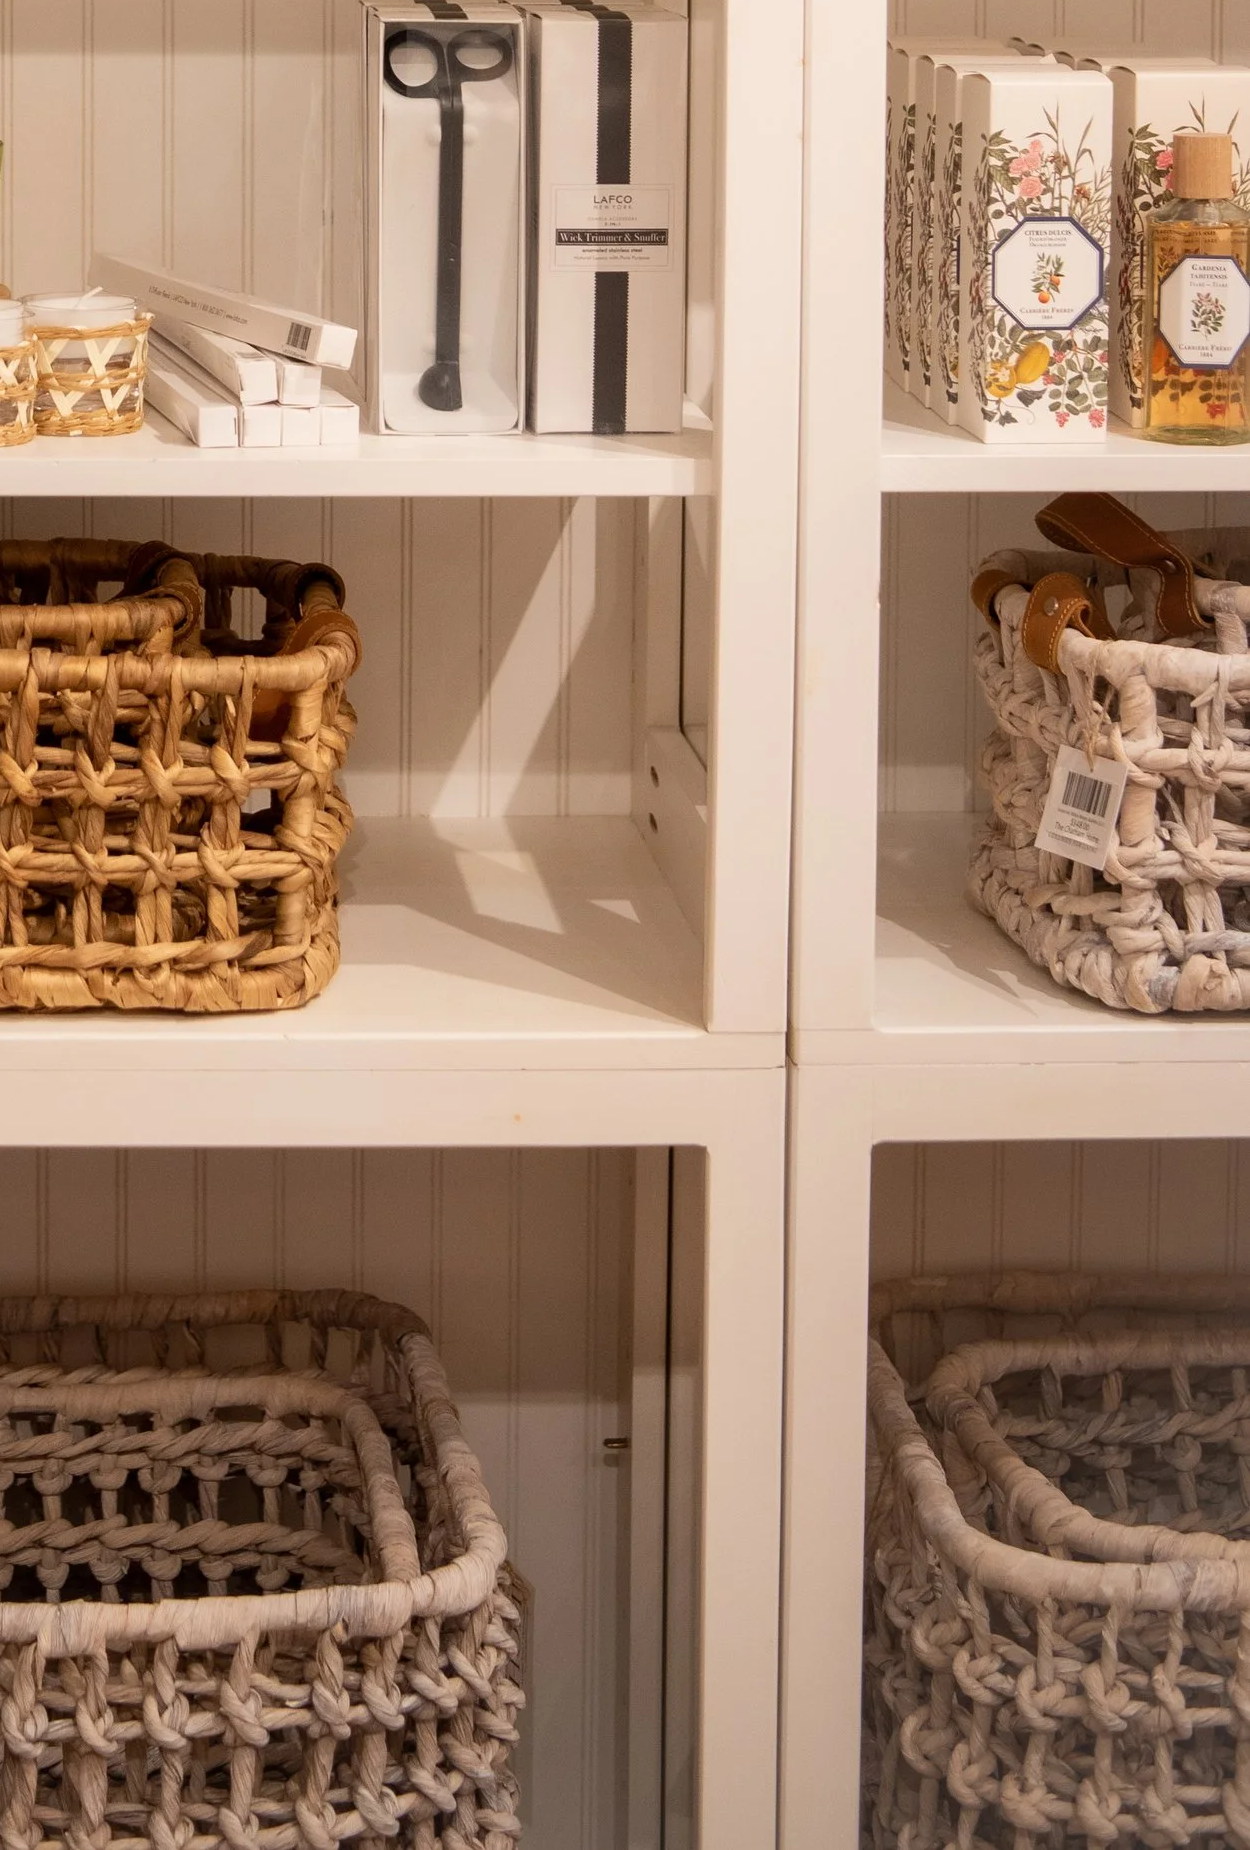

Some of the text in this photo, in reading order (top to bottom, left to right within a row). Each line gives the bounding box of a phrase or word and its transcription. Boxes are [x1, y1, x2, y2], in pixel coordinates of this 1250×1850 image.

[594, 195, 632, 204] LAFCO
[560, 232, 666, 242] Wick Trimmer & Snuffer
